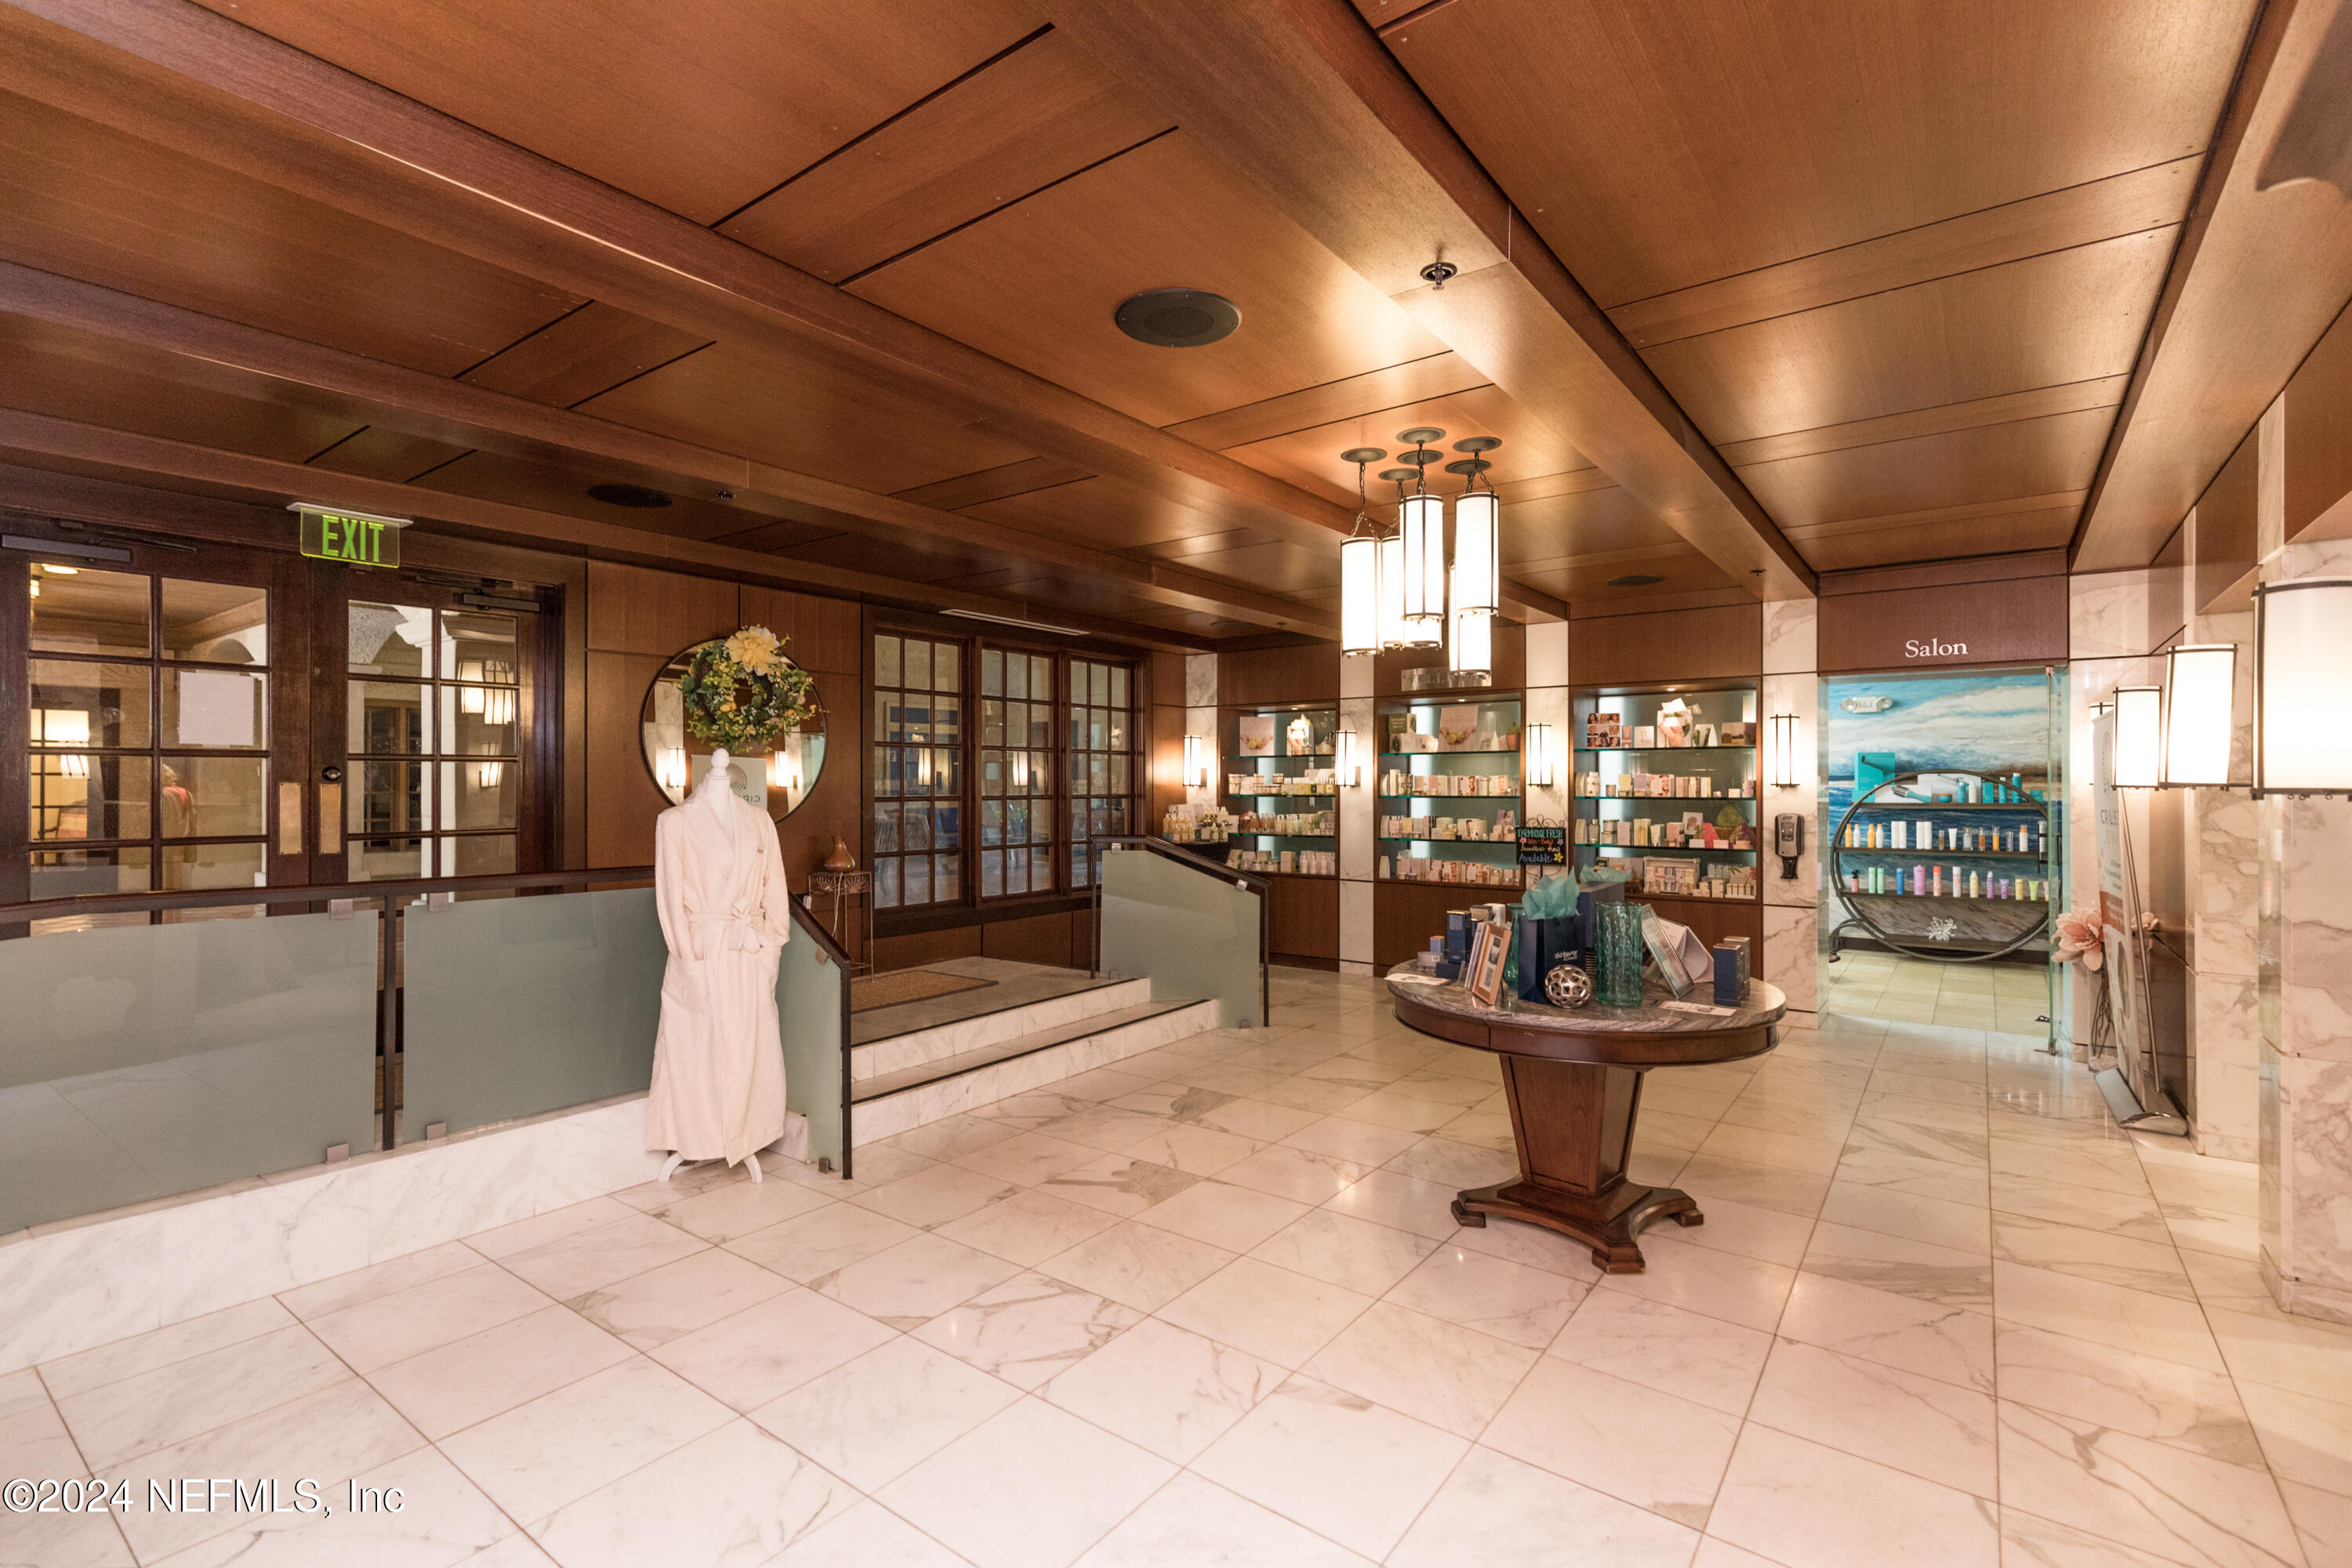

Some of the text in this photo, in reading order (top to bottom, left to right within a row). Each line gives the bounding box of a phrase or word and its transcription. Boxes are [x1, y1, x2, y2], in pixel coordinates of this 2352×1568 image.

[321, 514, 384, 563] EXIT
[1905, 637, 1969, 658] Salon
[1518, 829, 1545, 838] FARMHOUSE
[1519, 853, 1554, 863] Available
